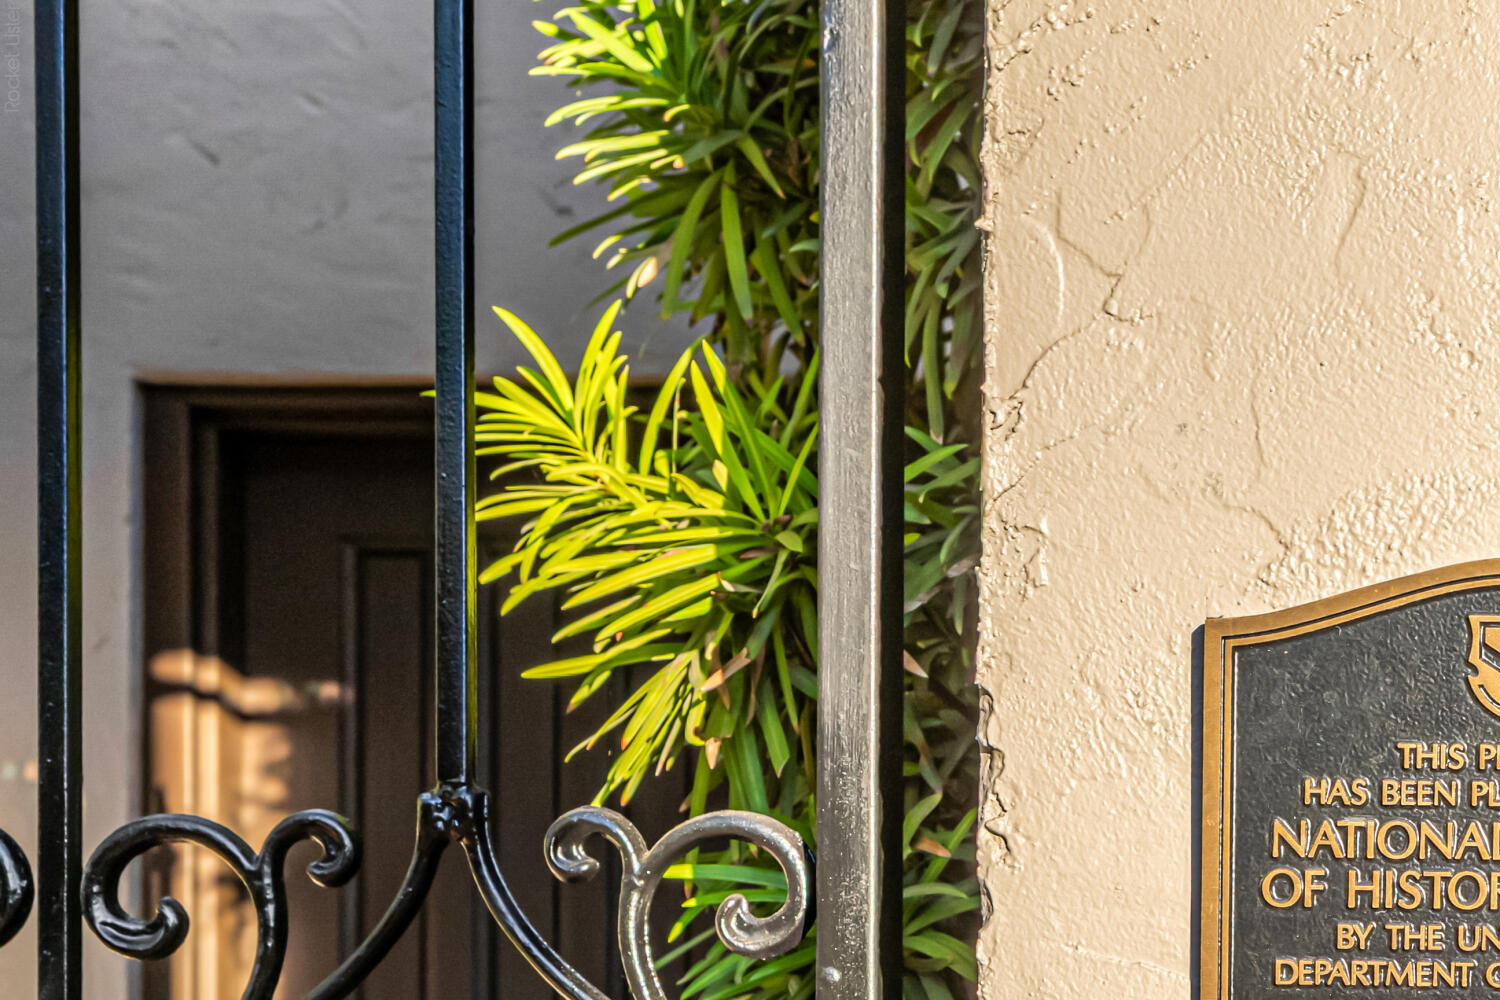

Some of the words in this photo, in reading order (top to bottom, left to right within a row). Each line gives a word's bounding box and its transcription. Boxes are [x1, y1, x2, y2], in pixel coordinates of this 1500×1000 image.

[1398, 743, 1465, 770] THIS
[1305, 779, 1366, 805] HAS
[1382, 779, 1457, 806] BEEN
[1262, 869, 1327, 908] OF
[1337, 923, 1372, 950] BY
[1386, 924, 1442, 950] THE
[1275, 959, 1472, 987] DEPARTMENT
